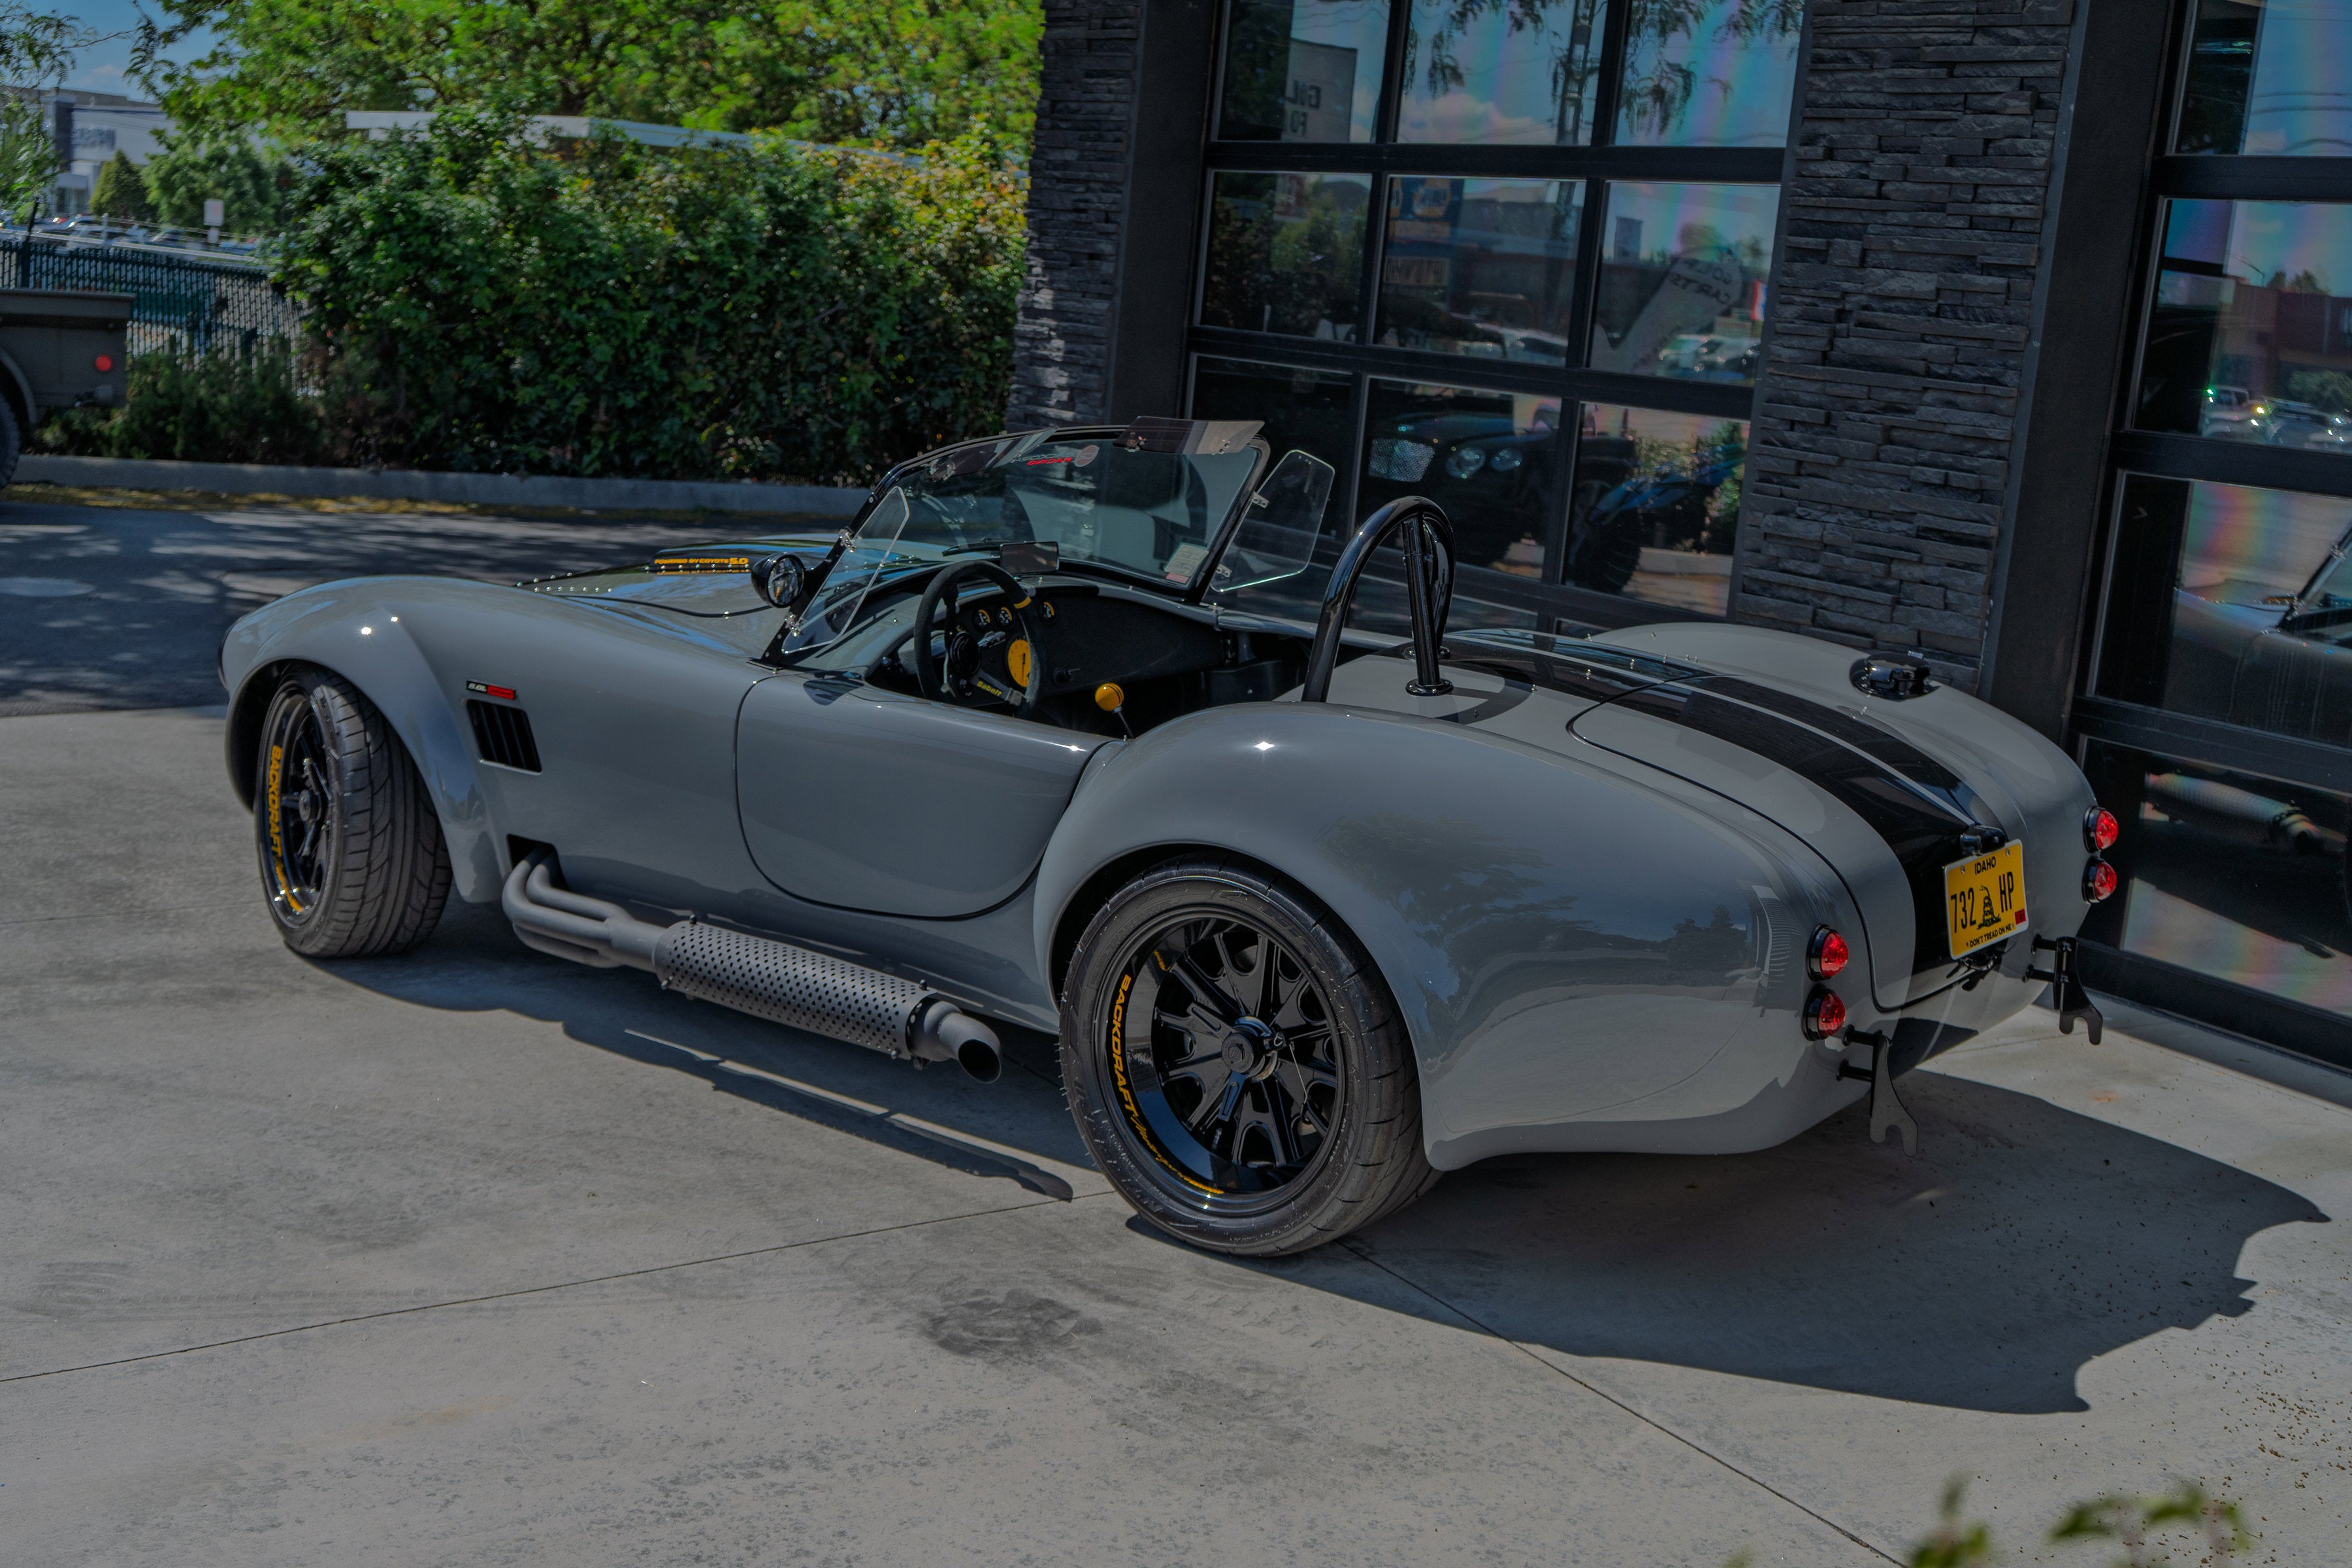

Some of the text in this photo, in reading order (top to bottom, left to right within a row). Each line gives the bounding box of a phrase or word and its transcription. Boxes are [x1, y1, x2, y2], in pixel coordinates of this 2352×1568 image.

[729, 557, 749, 565] 5.0
[268, 743, 283, 858] BACKDRAFT
[1974, 856, 1997, 875] IDAHO
[1950, 871, 2014, 934] 732 HP
[1970, 924, 2012, 948] DON'T TREAD ON ME
[1111, 973, 1139, 1119] BACKDRAFT
